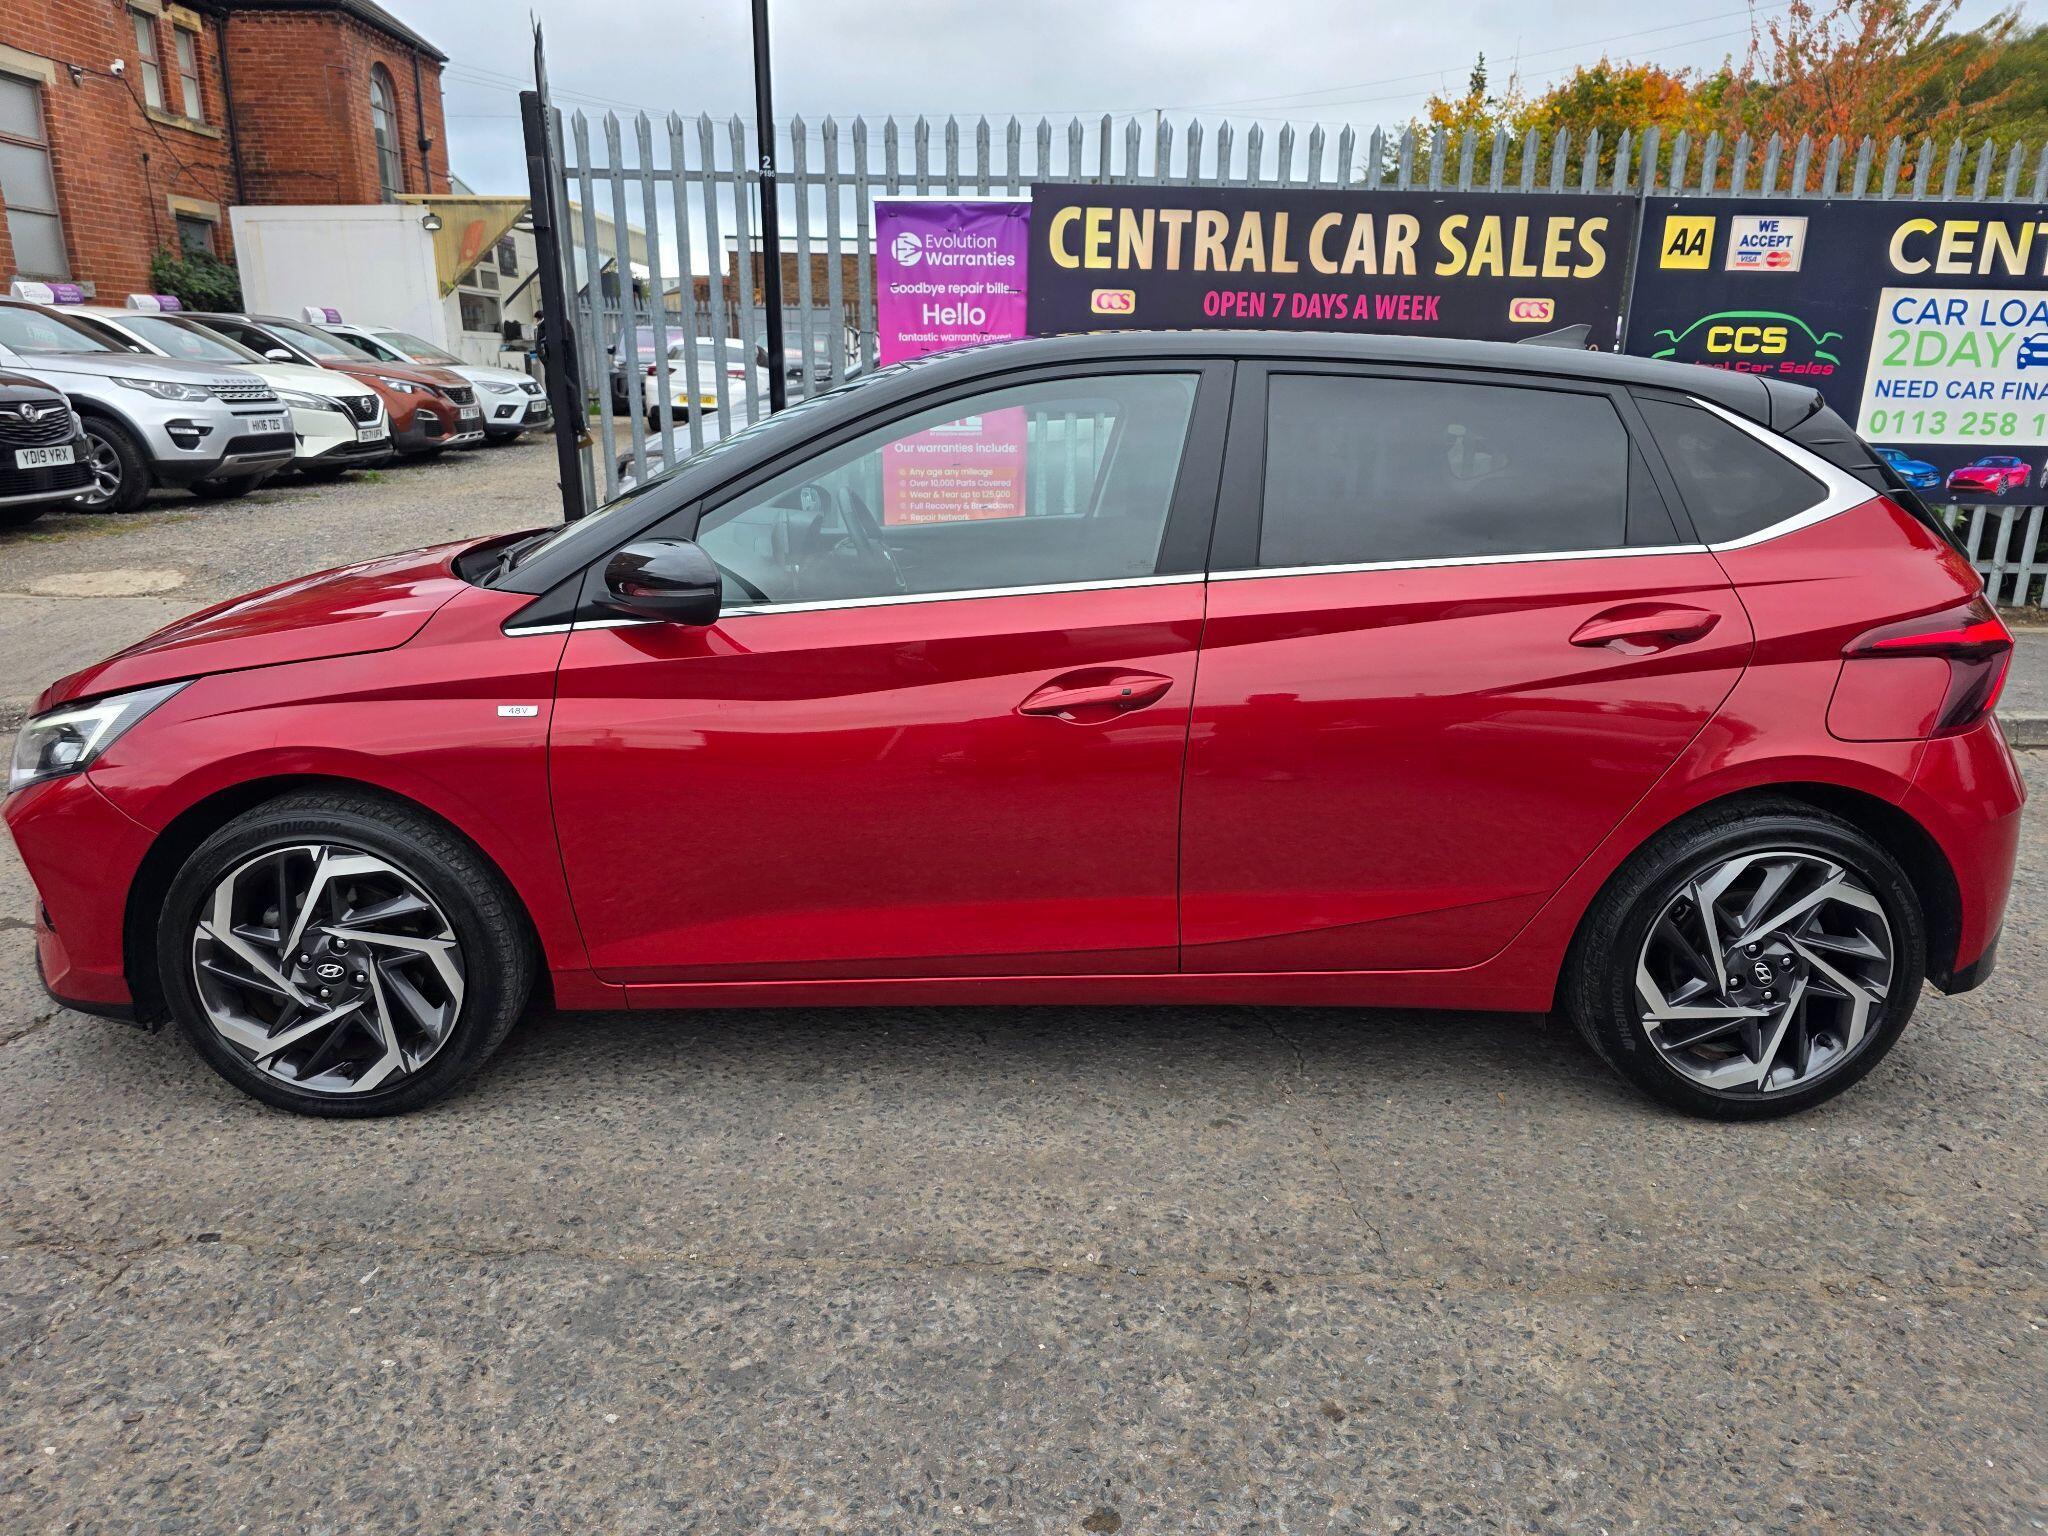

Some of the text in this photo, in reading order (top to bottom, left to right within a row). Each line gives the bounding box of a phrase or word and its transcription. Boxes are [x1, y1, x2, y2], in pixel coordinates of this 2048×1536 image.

[762, 156, 771, 168] 2
[1759, 220, 1779, 232] WE
[926, 234, 996, 248] Evolution
[1050, 206, 1608, 278] CENTRAL CAR SALES
[1667, 228, 1707, 256] AA
[1740, 234, 1793, 248] ACCEPT
[926, 252, 1015, 266] Warranties
[890, 282, 945, 296] Goodbye
[948, 282, 984, 296] repair
[1204, 291, 1441, 321] OPEN 7 DAYS A WEEK
[1892, 297, 1968, 326] CAR
[923, 303, 986, 326] Hello
[899, 332, 938, 342] fantastic
[940, 334, 982, 343] warranty
[1706, 326, 1788, 354] CCS
[1882, 330, 2016, 368] 2DAY
[1735, 361, 1774, 373] Car
[1779, 361, 1834, 375] Sales
[1874, 380, 1939, 398] NEED
[1946, 381, 1994, 400] CAR
[1870, 410, 1947, 435] 0113
[1958, 411, 2018, 436] 258
[894, 443, 1018, 453] Our warranties include:
[22, 448, 68, 465] YD19 YRX
[910, 468, 925, 476] Any
[926, 469, 942, 477] age
[961, 468, 992, 477] mileage
[978, 480, 1012, 488] Covered
[910, 502, 924, 510] Full
[926, 502, 962, 512] Recovery
[962, 502, 970, 510] &
[910, 513, 970, 522] Repair Network
